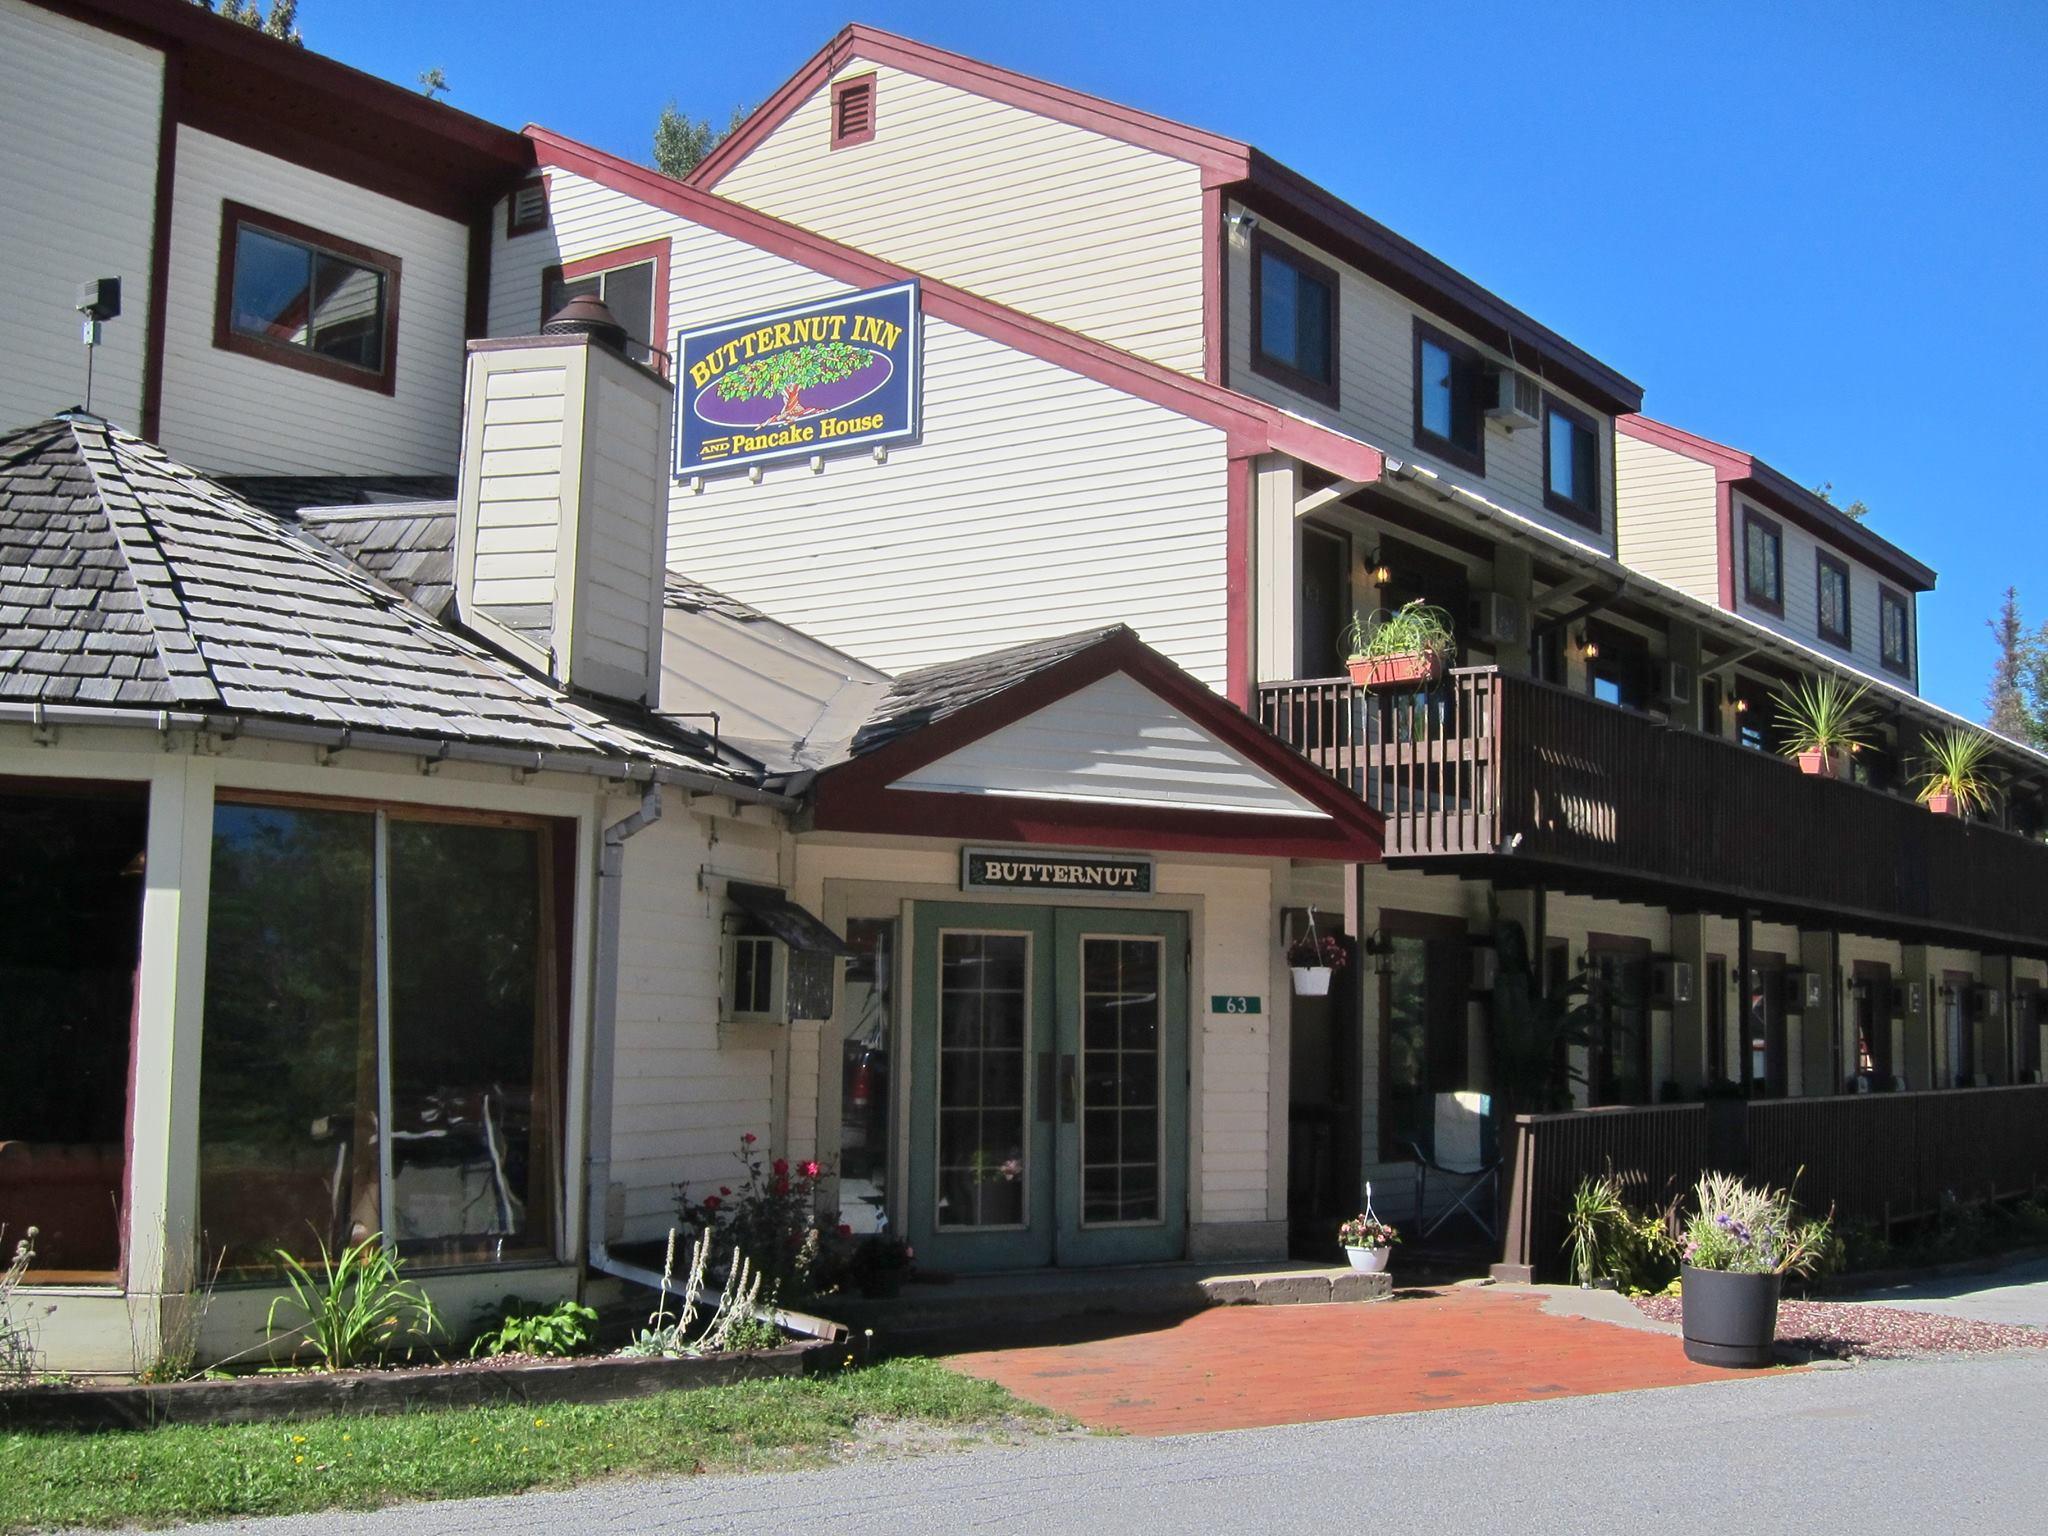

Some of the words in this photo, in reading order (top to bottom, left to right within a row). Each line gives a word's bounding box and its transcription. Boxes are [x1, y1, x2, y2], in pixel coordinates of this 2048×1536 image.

[689, 315, 847, 389] BUTTERNUT
[851, 315, 903, 351] INN
[700, 441, 730, 454] AND
[731, 424, 813, 454] Pancake
[819, 413, 884, 439] House
[985, 861, 1137, 886] BUTTERNUT
[1226, 997, 1247, 1013] 63
